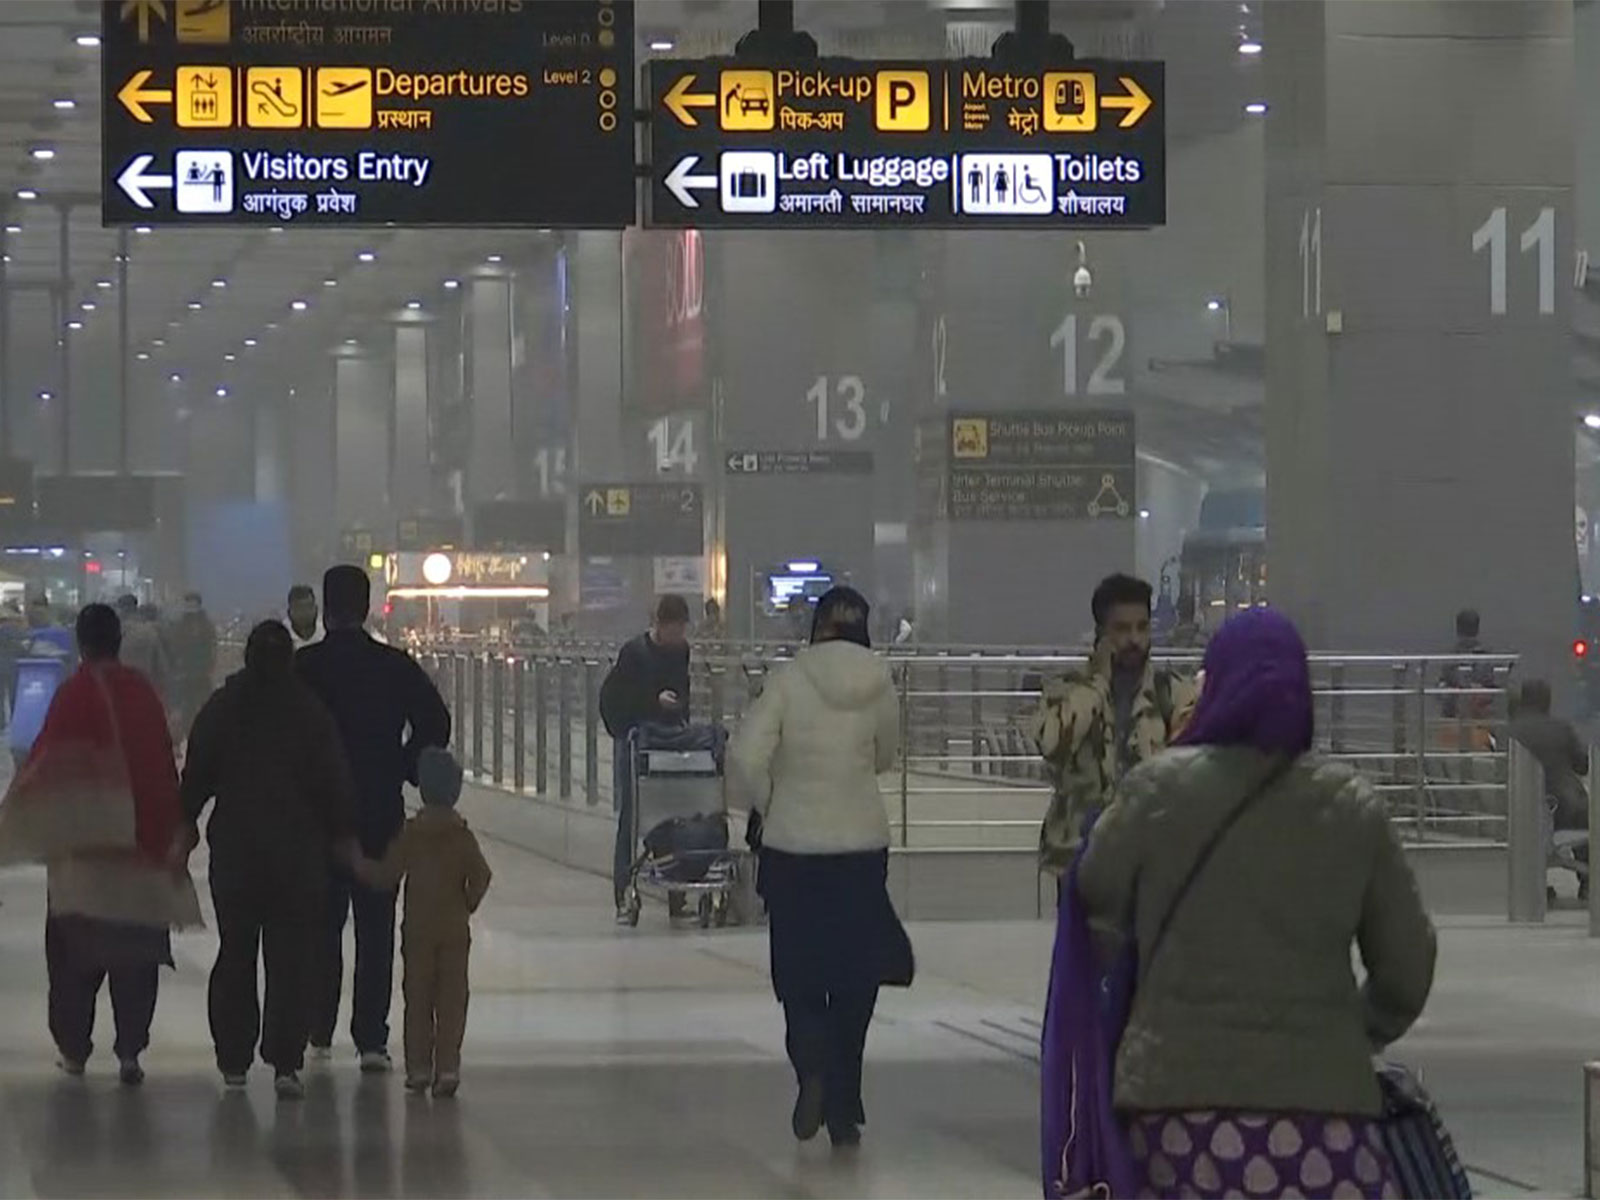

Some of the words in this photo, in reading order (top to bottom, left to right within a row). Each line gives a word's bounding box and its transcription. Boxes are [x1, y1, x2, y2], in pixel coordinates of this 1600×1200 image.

[334, 26, 394, 45] आगमन
[376, 69, 528, 100] Departures
[543, 69, 578, 84] Level
[582, 69, 591, 84] 2
[778, 71, 871, 102] Pick-up
[962, 72, 1039, 99] Metro
[890, 81, 916, 119] P
[377, 108, 431, 130] प्रस्थान
[780, 107, 843, 131] पिक-अप
[1008, 108, 1040, 134] मेट्रो
[243, 152, 347, 180] Visitors
[358, 152, 430, 187] Entry
[778, 152, 829, 179] Left
[838, 152, 947, 187] Luggage
[1055, 153, 1140, 181] Toilets
[243, 190, 308, 218] आगंतुक
[316, 190, 356, 214] प्रवेश
[779, 189, 842, 213] अमानती
[852, 194, 923, 213] सामानघर
[1058, 190, 1125, 214] शौचालय
[1472, 207, 1555, 314] 11
[1050, 314, 1125, 394] 12
[806, 376, 866, 440] 13
[647, 417, 697, 475] 14
[681, 489, 694, 512] 2
